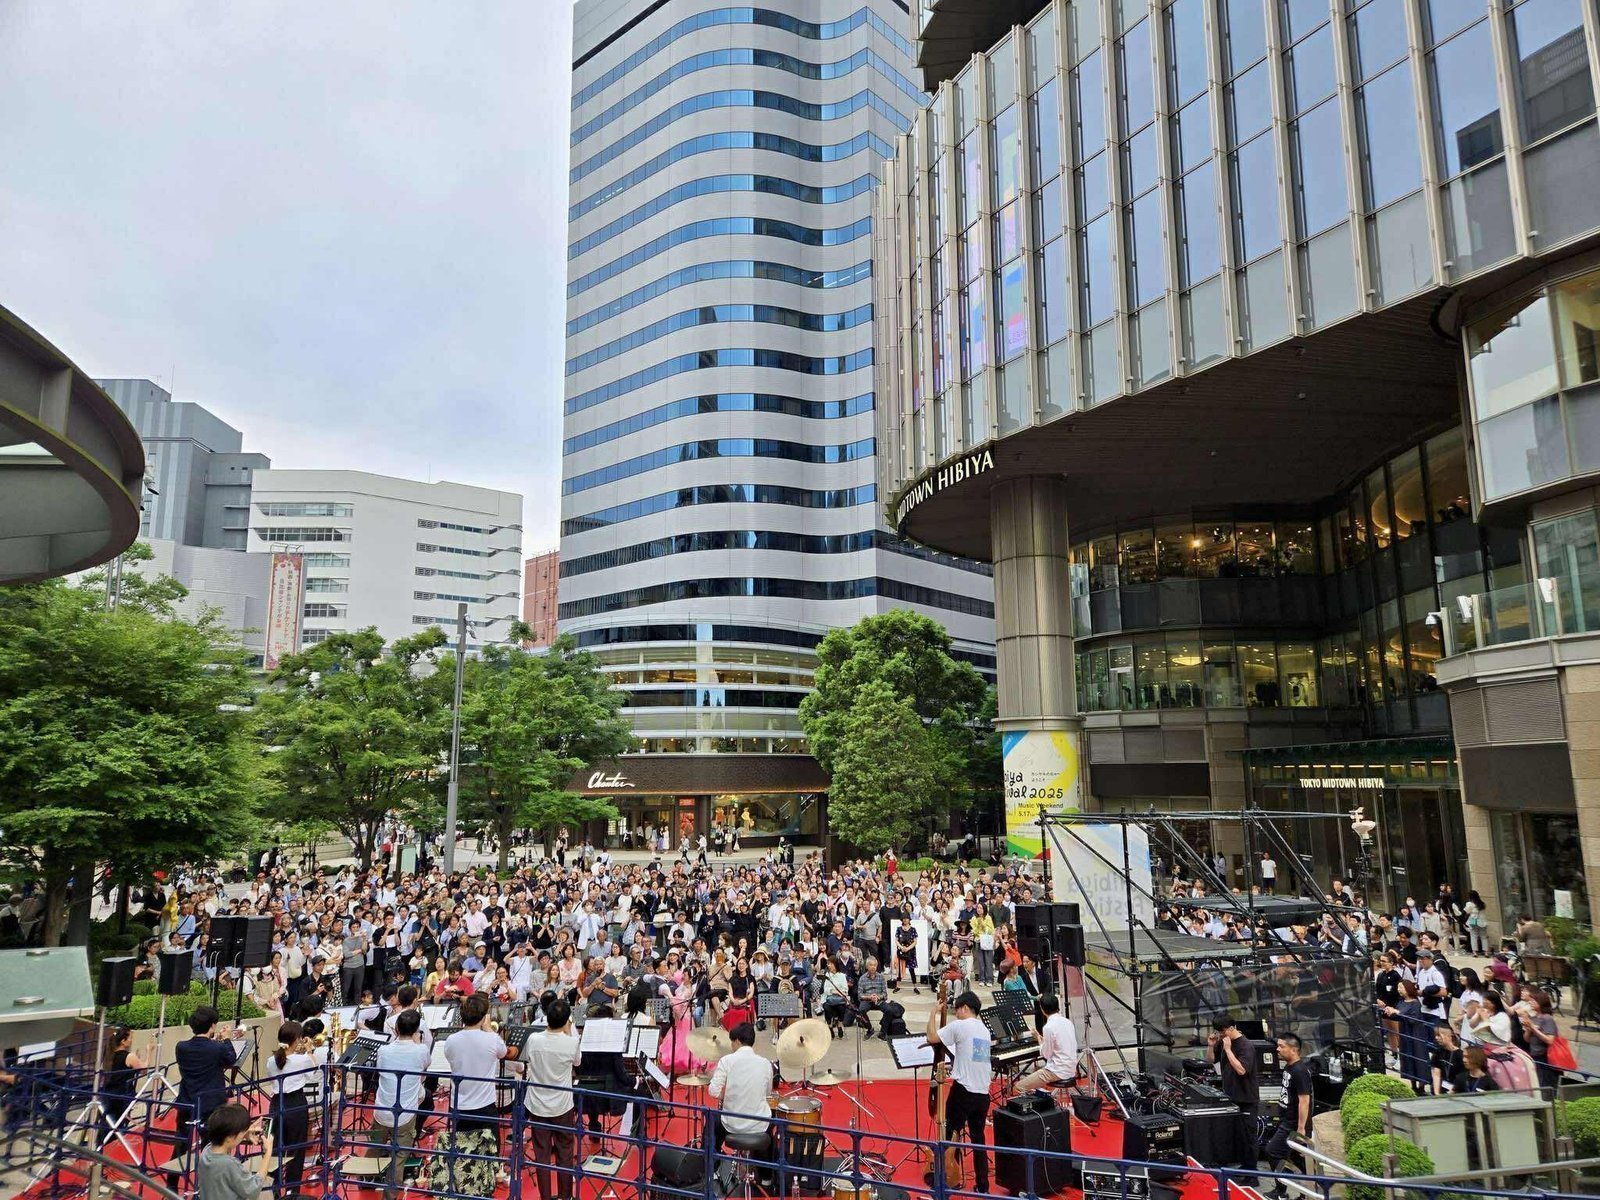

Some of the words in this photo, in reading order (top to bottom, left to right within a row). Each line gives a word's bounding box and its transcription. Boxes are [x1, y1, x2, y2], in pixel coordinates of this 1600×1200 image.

[938, 450, 994, 491] HIBIYA
[1300, 778, 1321, 788] TOKYO
[1322, 778, 1356, 788] MIDTOWN
[1358, 778, 1384, 788] HIBIYA
[1029, 787, 1064, 800] 2025
[1155, 1131, 1174, 1139] Roland
